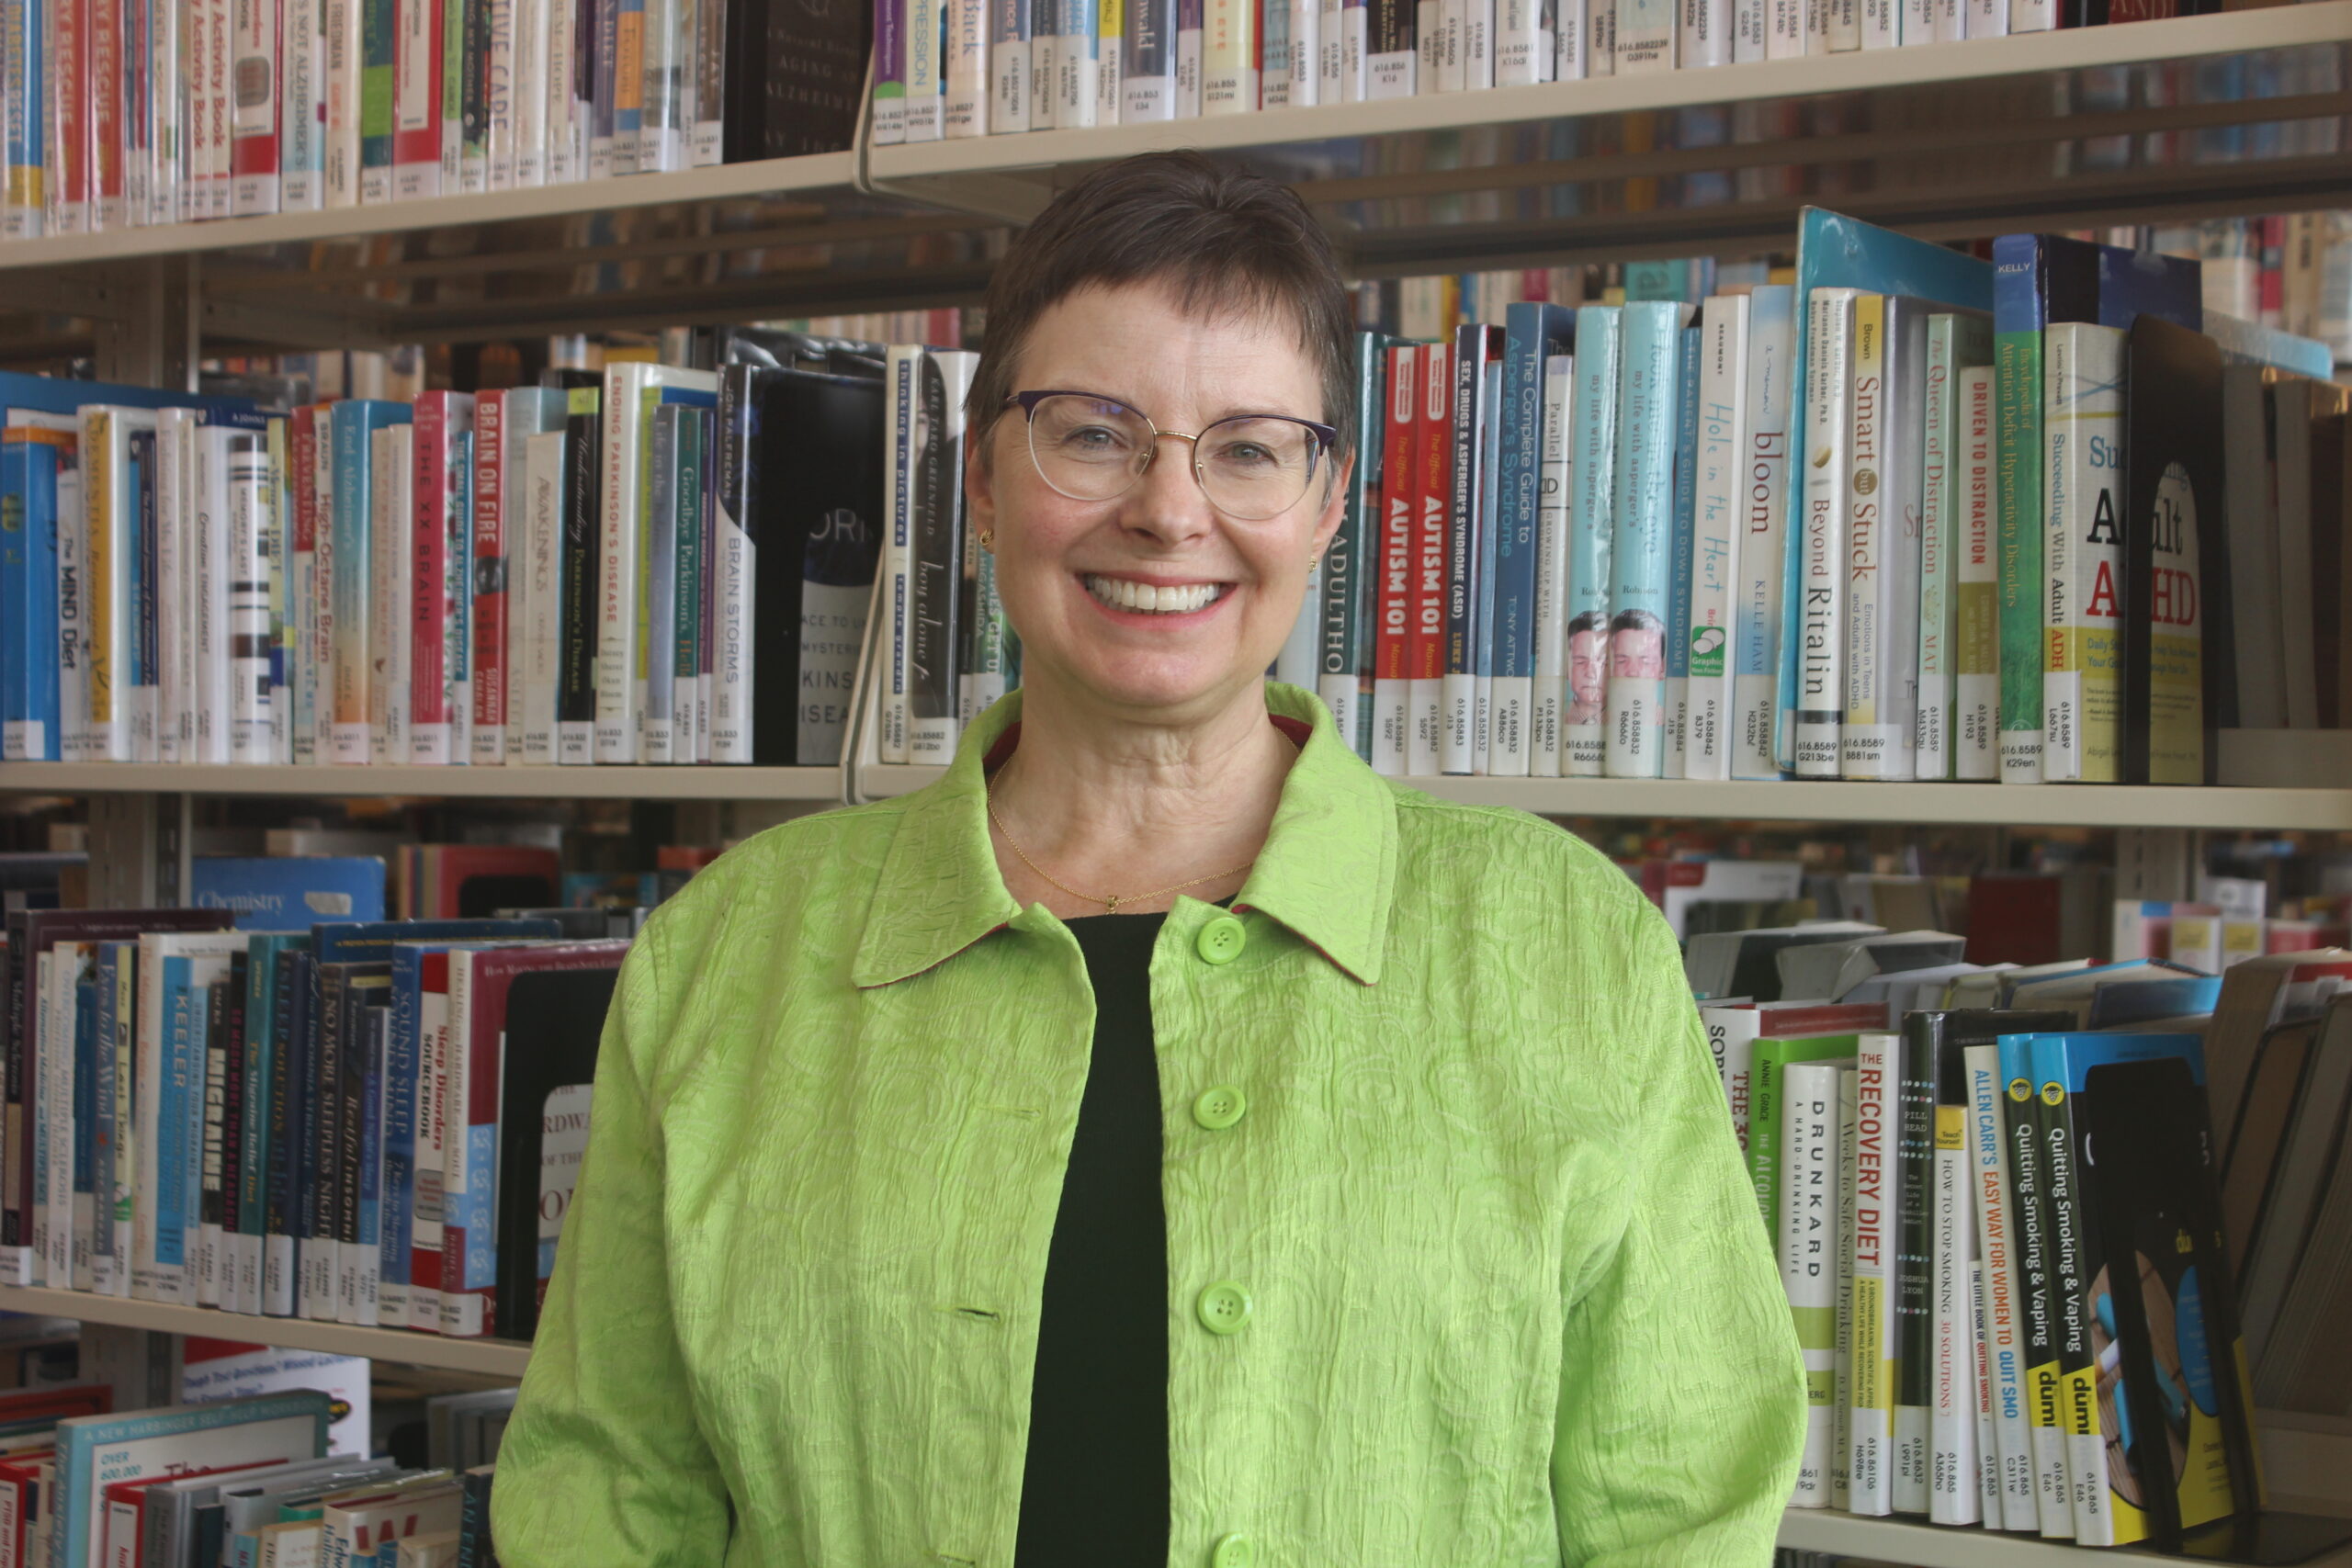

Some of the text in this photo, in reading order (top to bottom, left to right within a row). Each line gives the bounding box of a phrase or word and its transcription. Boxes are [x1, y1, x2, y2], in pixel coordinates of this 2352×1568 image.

[58, 31, 73, 125] RESCUE
[96, 29, 110, 124] RESCUE
[192, 15, 205, 151] Activity Book
[211, 12, 225, 147] Activity Book
[330, 4, 343, 69] FRIEDMAN
[301, 433, 313, 542] PREVENTING
[478, 402, 498, 543] BRAIN ON FIRE
[894, 363, 910, 544] thinking in pictures
[926, 377, 940, 536] KARL TARO GREENFELD
[1452, 360, 1471, 618] SEX, DRUGS & ASPERGER'S SYNDROME (ASD)
[1500, 335, 1522, 558] Asperger's Syndrome
[1518, 349, 1538, 544] The Complete Guide to
[1547, 402, 1561, 457] Parallel
[1751, 432, 1783, 534] bloom
[1850, 323, 1880, 581] Brown Smart but Stuck
[1923, 337, 1945, 574] The Queen of Distraction
[1970, 382, 1988, 565] DRIVEN TO DISTRACTION
[1999, 342, 2019, 607] Attention Deficit Hyperactivity Disorders
[319, 423, 333, 663] BRAUN High-Octane Brain
[418, 442, 432, 622] THE XX BRAIN
[536, 476, 551, 592] AWAKENINGS
[606, 376, 623, 623] ENDING PARKINSON'S DISEASE
[1387, 435, 1408, 678] The Official AUTISM 101 Manua
[1421, 434, 1442, 678] The Official AUTISM 101 Manua
[1704, 402, 1734, 592] Hole in the Heart
[2048, 434, 2067, 670] Succeeding With Adult ADH
[61, 566, 77, 619] MIND
[198, 513, 209, 654] Creative ENGAGEMENT
[571, 435, 589, 693] Understanding PARKINSON'S DISEASE
[725, 537, 741, 683] BRAIN STORMS
[917, 560, 944, 660] boy alone
[976, 557, 988, 638] HIGASHIDA
[1674, 536, 1688, 670] DOWN SYNDROME
[1752, 581, 1766, 671] KELLE HAM
[1804, 498, 1833, 695] Beyond Ritalin
[61, 628, 78, 669] Diet
[893, 577, 904, 694] temple grandin
[1692, 657, 1724, 666] Graphic
[1862, 604, 1872, 699] Emotions in Teens
[1704, 700, 1714, 755] 616.858842
[1758, 700, 1769, 757] 616.858842
[1798, 741, 1837, 751] 616.8589
[1799, 752, 1835, 762] G213be
[1929, 706, 1939, 751] 616.8589
[2006, 757, 2036, 768] K29en
[198, 890, 286, 912] Chemistry
[173, 995, 187, 1088] KEELER
[396, 991, 412, 1134] SOUND SLEEP
[419, 1033, 433, 1139] SOURCEBOOK
[433, 1024, 449, 1151] Sleep Disorders
[1758, 1060, 1771, 1122] ANNIE GRACE
[116, 1061, 128, 1160] Last Things
[203, 1047, 225, 1191] MIGRAINE
[245, 1041, 259, 1203] The Migraine Relief Diet
[318, 998, 338, 1239] NO MORE SLEEPLESS NIGHT
[1857, 1068, 1883, 1267] RECOVERY DIET
[1905, 1111, 1928, 1120] PILL
[1806, 1101, 1825, 1278] DRUNKARD
[1974, 1069, 2016, 1385] ALLEN CARR'S EASY WAY FOR WOMEN TO QUIT
[2015, 1123, 2051, 1347] Quitting Smoking & Vaping
[2047, 1127, 2085, 1353] Quitting Smoking & Vaping
[1939, 1159, 1953, 1409] HOW TO STOP SMOKING 30 SOLUTIONS
[100, 1451, 130, 1467] OVER
[1865, 1438, 1877, 1490] 616.86106
[1912, 1437, 1925, 1485] 616.8632
[2018, 1454, 2030, 1496] 616.865
[2041, 1473, 2053, 1492] E46
[2053, 1461, 2065, 1504] 616.865
[2075, 1483, 2086, 1502] E46
